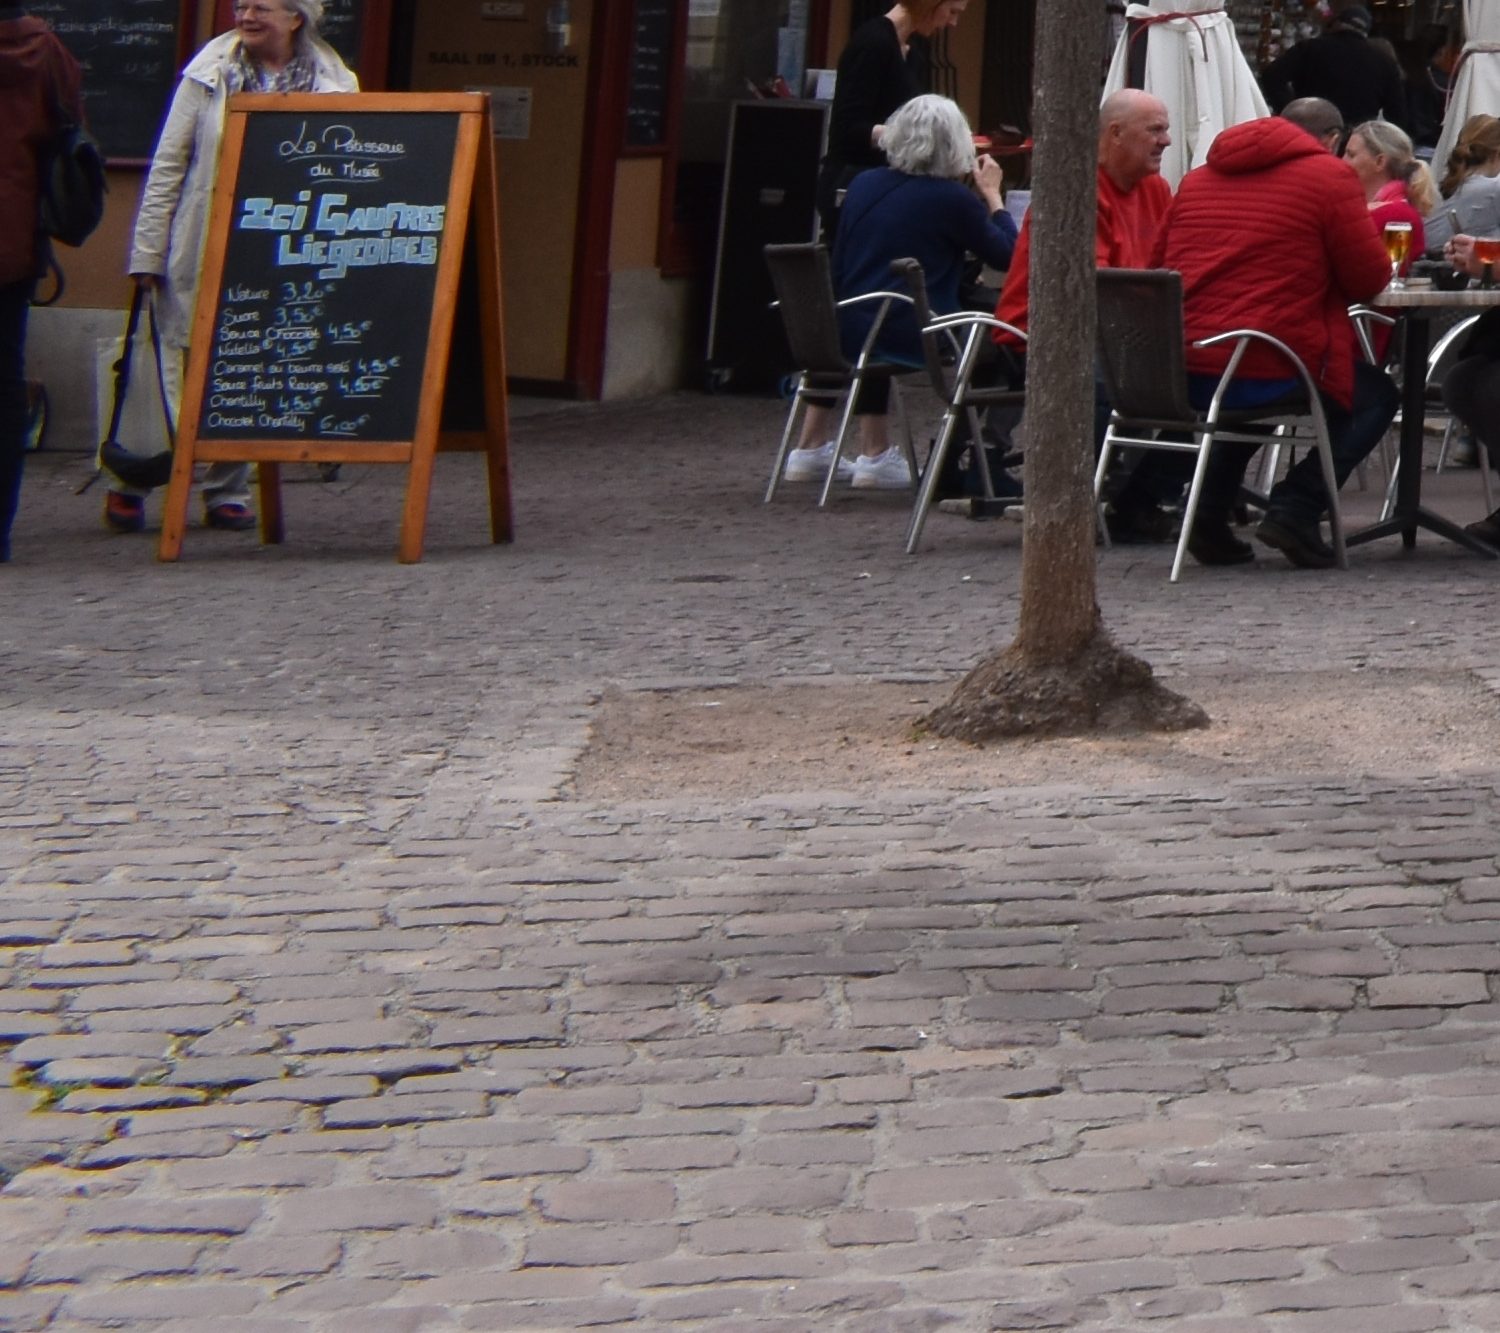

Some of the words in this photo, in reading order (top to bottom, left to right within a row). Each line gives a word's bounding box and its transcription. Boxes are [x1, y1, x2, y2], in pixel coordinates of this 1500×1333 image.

[428, 51, 469, 66] SAAL
[477, 52, 496, 66] IM
[520, 53, 579, 68] STOCK
[279, 121, 318, 156] La
[310, 162, 334, 177] du
[342, 160, 381, 178] Musée
[228, 283, 271, 302] Nature
